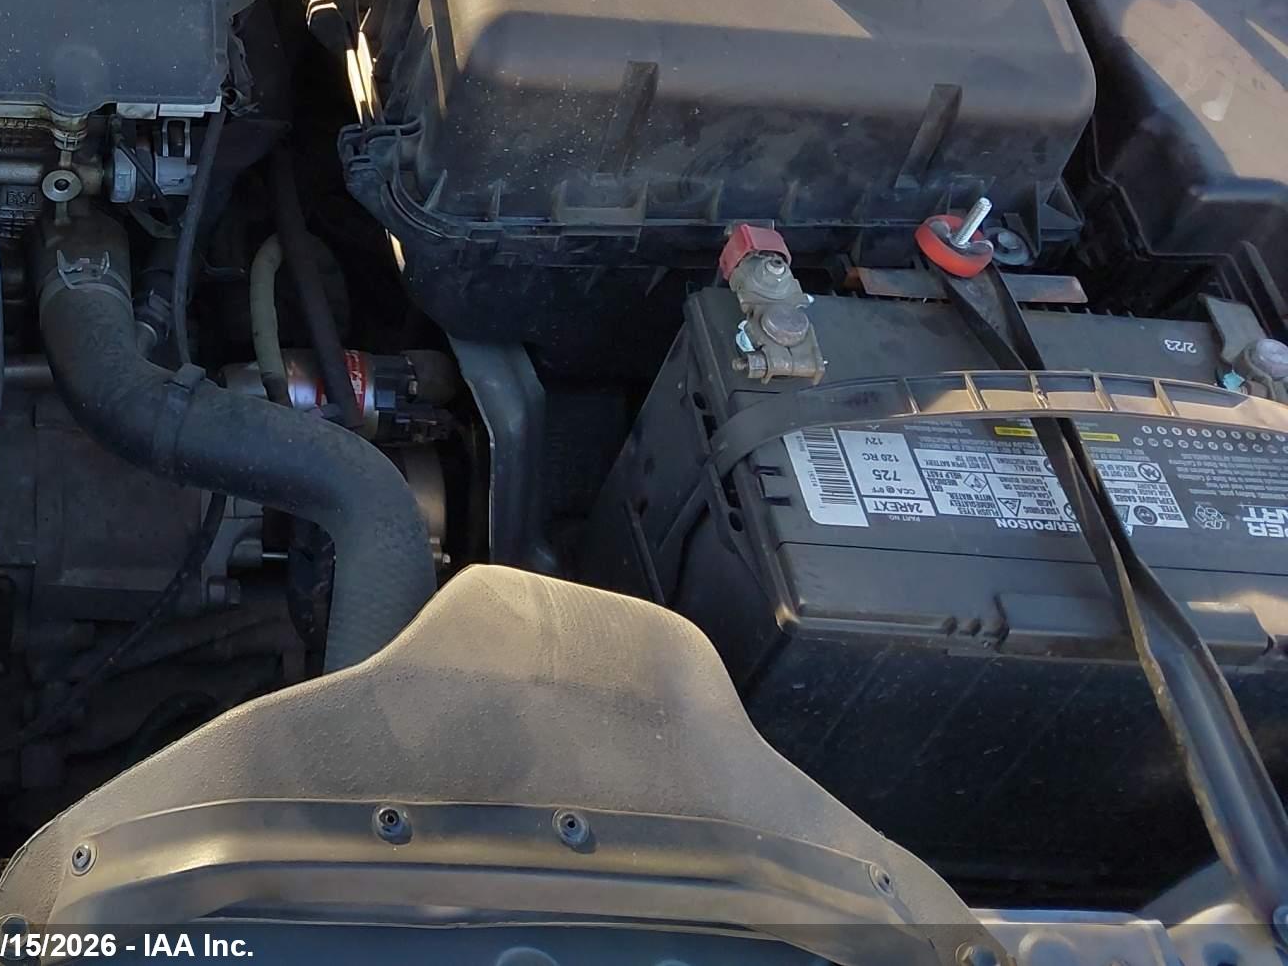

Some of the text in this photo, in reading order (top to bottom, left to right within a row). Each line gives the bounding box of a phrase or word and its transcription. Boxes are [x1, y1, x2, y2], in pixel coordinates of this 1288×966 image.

[1164, 339, 1197, 353] 2/23
[865, 437, 884, 445] 12V
[862, 453, 900, 462] 120 RC
[872, 469, 901, 481] 725
[874, 500, 923, 513] 24REXT
